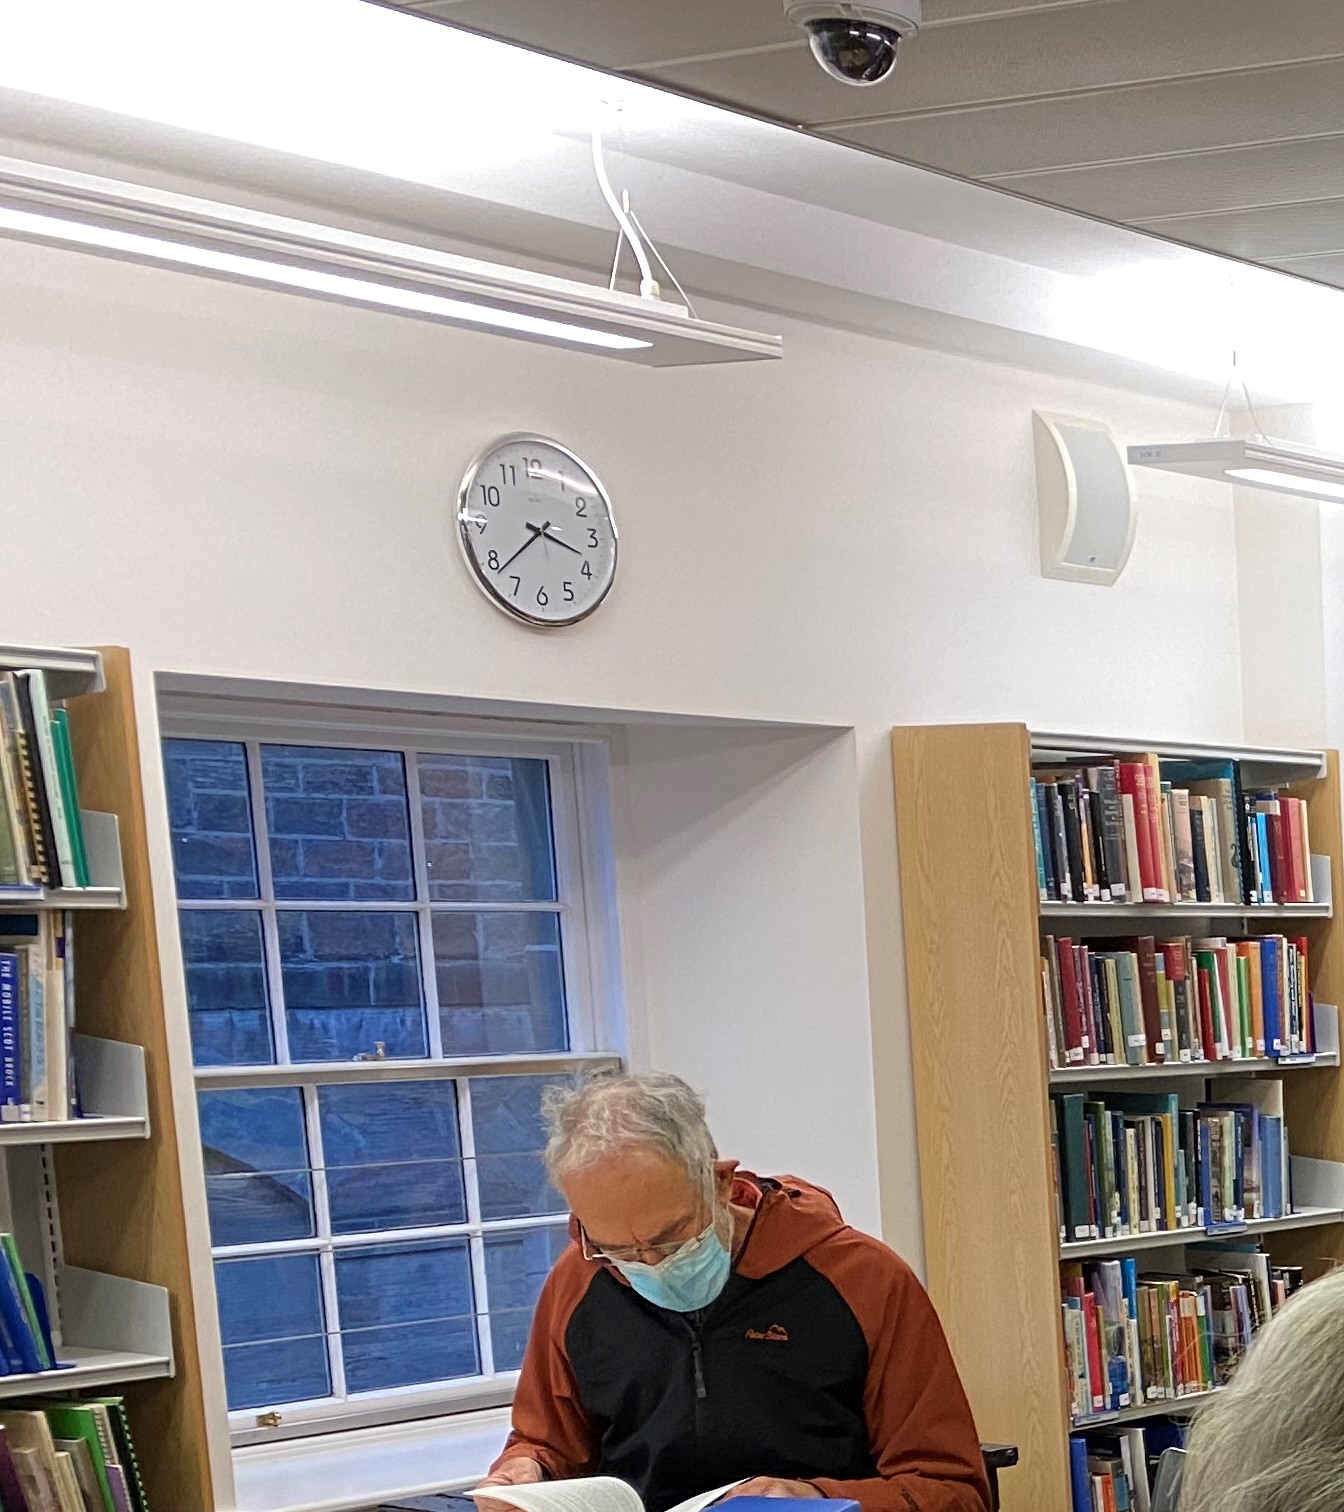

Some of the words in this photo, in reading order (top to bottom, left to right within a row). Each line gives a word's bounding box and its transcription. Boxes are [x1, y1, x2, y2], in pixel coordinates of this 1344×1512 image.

[499, 463, 516, 486] 11
[522, 457, 543, 481] 12
[558, 470, 565, 492] 1
[480, 484, 500, 507] 10
[575, 496, 588, 518] 2
[475, 514, 488, 535] 9
[586, 528, 598, 548] 3
[487, 549, 500, 571] 8
[580, 560, 593, 580] 4
[509, 575, 521, 596] 7
[536, 585, 549, 606] 6
[563, 581, 575, 602] 5
[0, 960, 12, 977] THE
[1, 983, 14, 1021] MOBILE
[2, 1027, 14, 1051] SCOT
